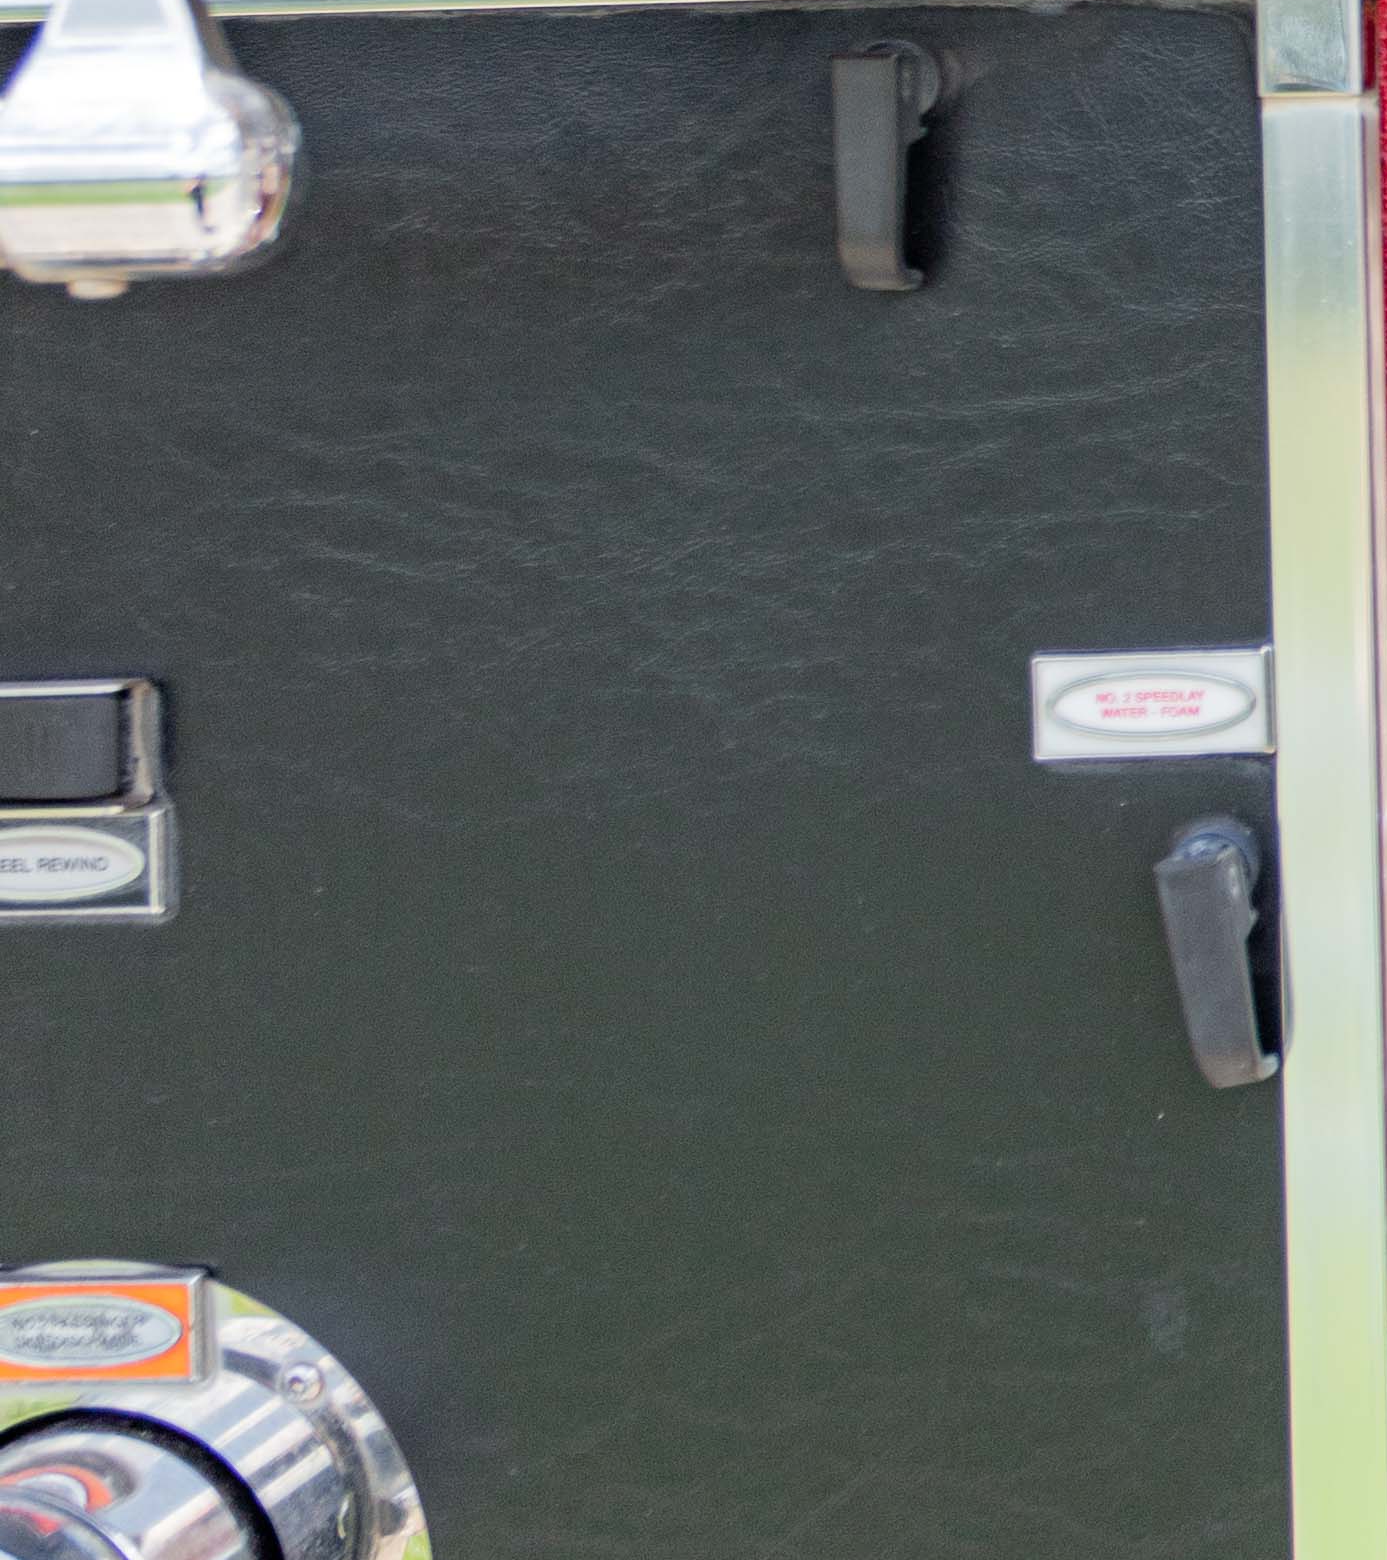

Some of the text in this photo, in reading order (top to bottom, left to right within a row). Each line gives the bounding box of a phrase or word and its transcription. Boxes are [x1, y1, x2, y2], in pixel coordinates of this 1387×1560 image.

[1135, 689, 1205, 703] SPEEDLAY
[1102, 706, 1147, 718] WATER
[0, 856, 109, 873] EEL REWIND
